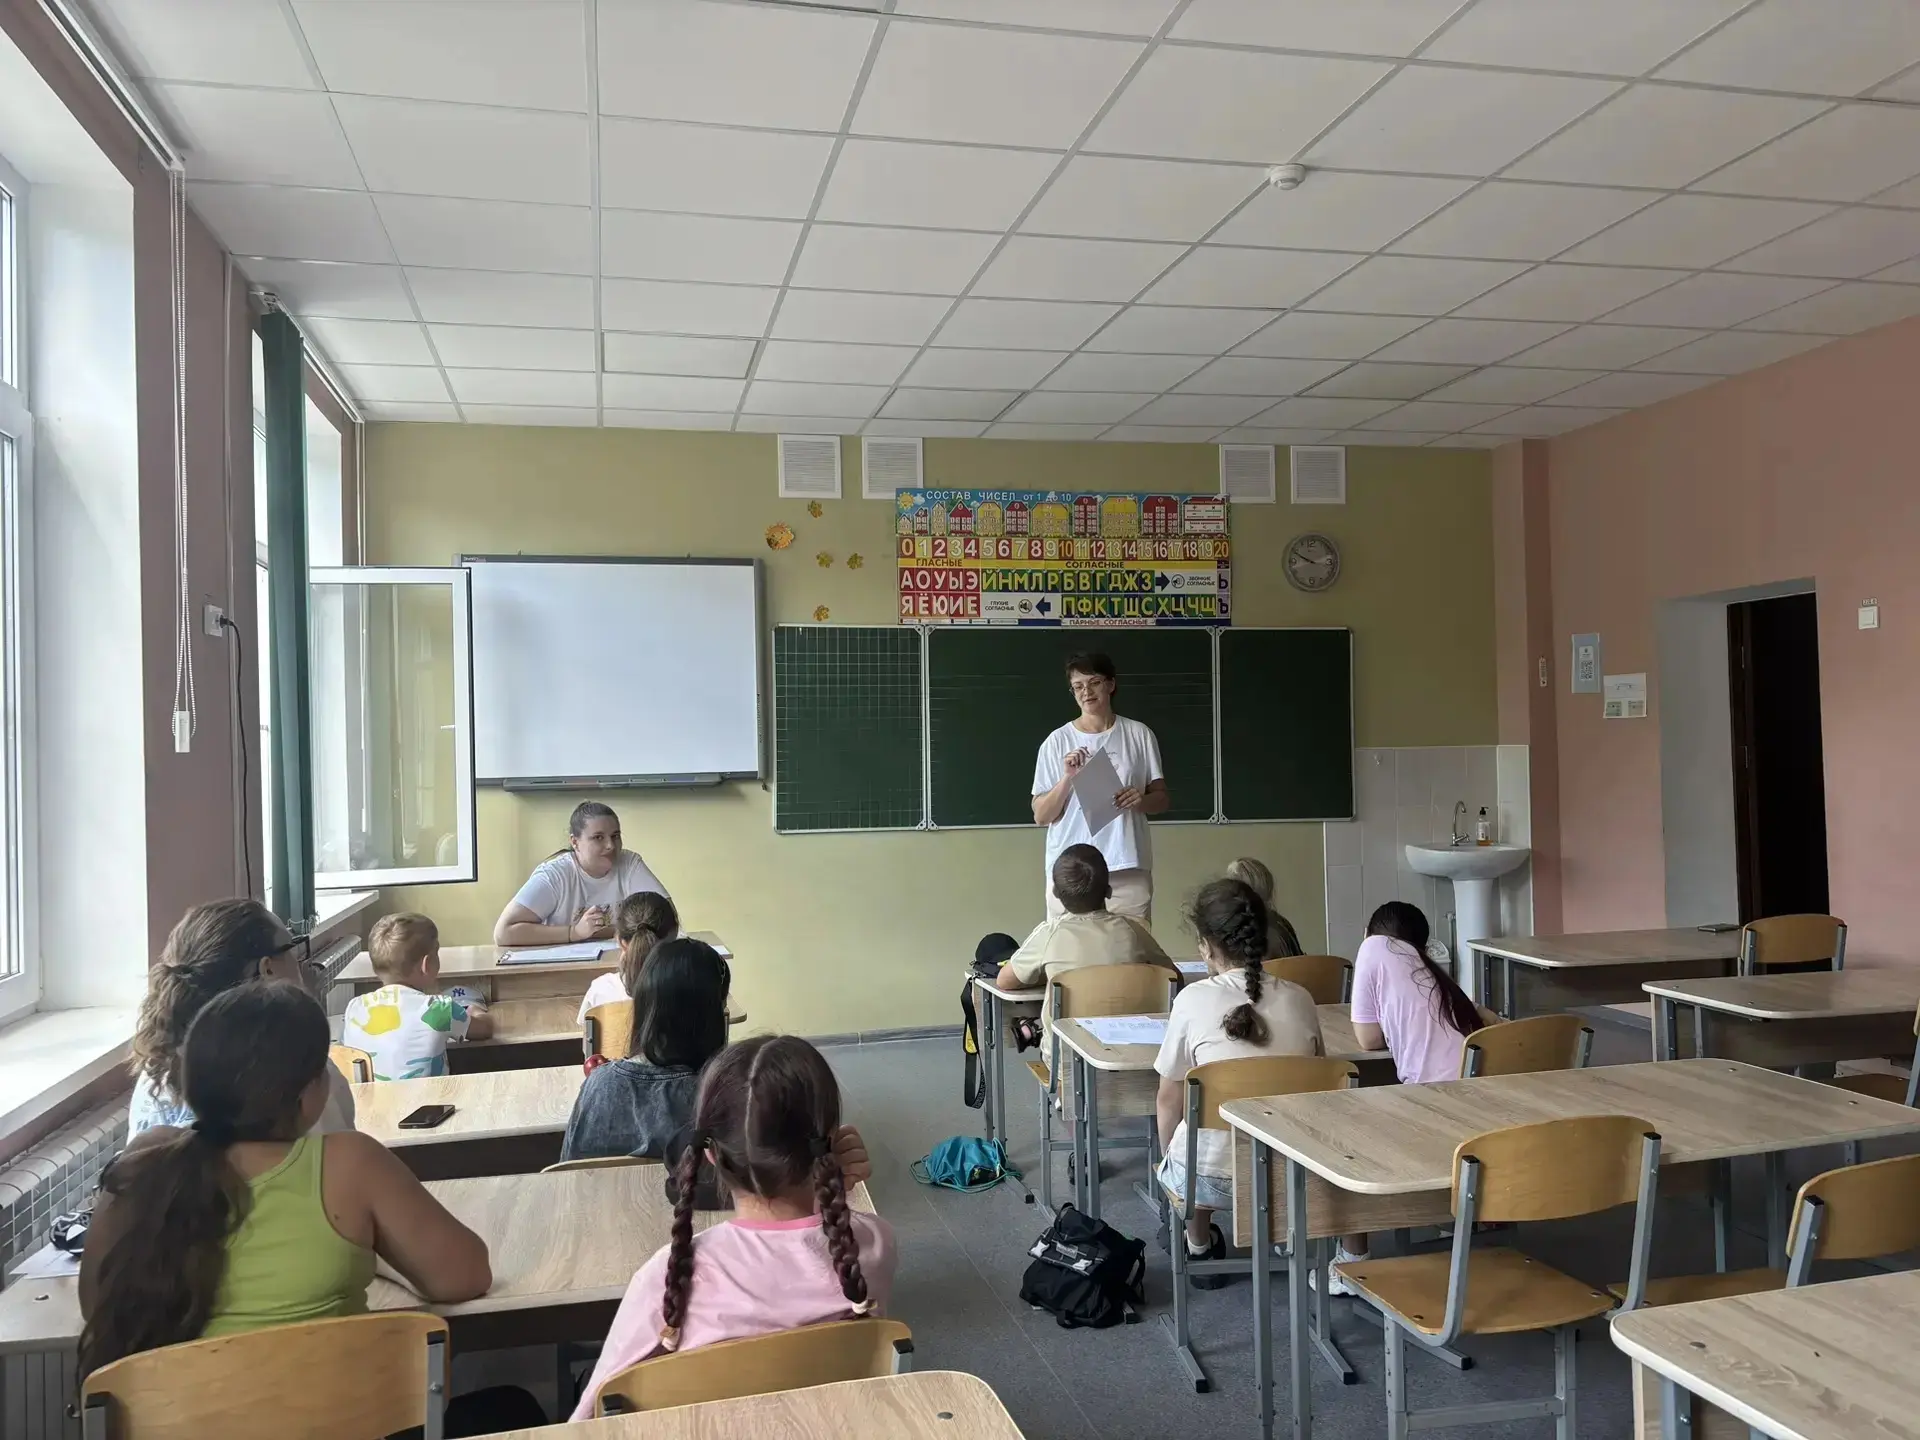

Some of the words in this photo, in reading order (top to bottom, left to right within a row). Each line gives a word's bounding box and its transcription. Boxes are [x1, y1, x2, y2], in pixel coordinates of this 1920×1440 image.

[926, 491, 971, 500] СОСТАВ
[979, 492, 1015, 500] ЧИСЕЛ
[902, 539, 913, 556] 0
[919, 540, 927, 556] 1
[934, 540, 946, 556] 2
[950, 540, 962, 556] 3
[965, 540, 977, 556] 4
[982, 540, 995, 557] 5
[998, 540, 1010, 557] 6
[1014, 540, 1026, 557] 7
[1031, 540, 1042, 557] 8
[1046, 540, 1057, 557] 9
[1060, 541, 1073, 557] 10
[1076, 541, 1086, 557] 11
[1091, 541, 1105, 557] 12
[1107, 541, 1121, 557] 13
[1123, 541, 1137, 557] 14
[1138, 541, 1152, 557] 15
[1153, 541, 1167, 557] 16
[1168, 542, 1182, 557] 17
[1184, 541, 1197, 557] 18
[1199, 542, 1212, 557] 19
[1214, 542, 1228, 558] 20
[901, 570, 913, 589] А
[916, 570, 930, 589] О
[934, 571, 946, 590] У
[949, 571, 962, 590] Ы
[966, 571, 978, 590] Э
[983, 570, 997, 590] Й
[999, 573, 1011, 590] Н
[1014, 573, 1029, 590] М
[1030, 573, 1043, 590] Л
[1048, 573, 1058, 590] Р
[1064, 573, 1075, 591] Б
[1079, 573, 1090, 591] В
[1096, 574, 1105, 591] Г
[1109, 573, 1122, 591] Д
[1124, 573, 1138, 591] Ж
[1142, 573, 1152, 590] З
[901, 596, 913, 614] Я
[933, 596, 948, 614] Ю
[949, 596, 963, 614] И
[968, 596, 977, 614] Е
[1063, 597, 1075, 615] П
[1078, 597, 1092, 615] Ф
[1095, 599, 1106, 615] К
[1111, 599, 1122, 615] Т
[1141, 597, 1153, 614] С
[1157, 598, 1168, 615] Х
[1171, 598, 1183, 615] Ц
[1188, 598, 1198, 615] Ч
[1201, 598, 1215, 615] Щ
